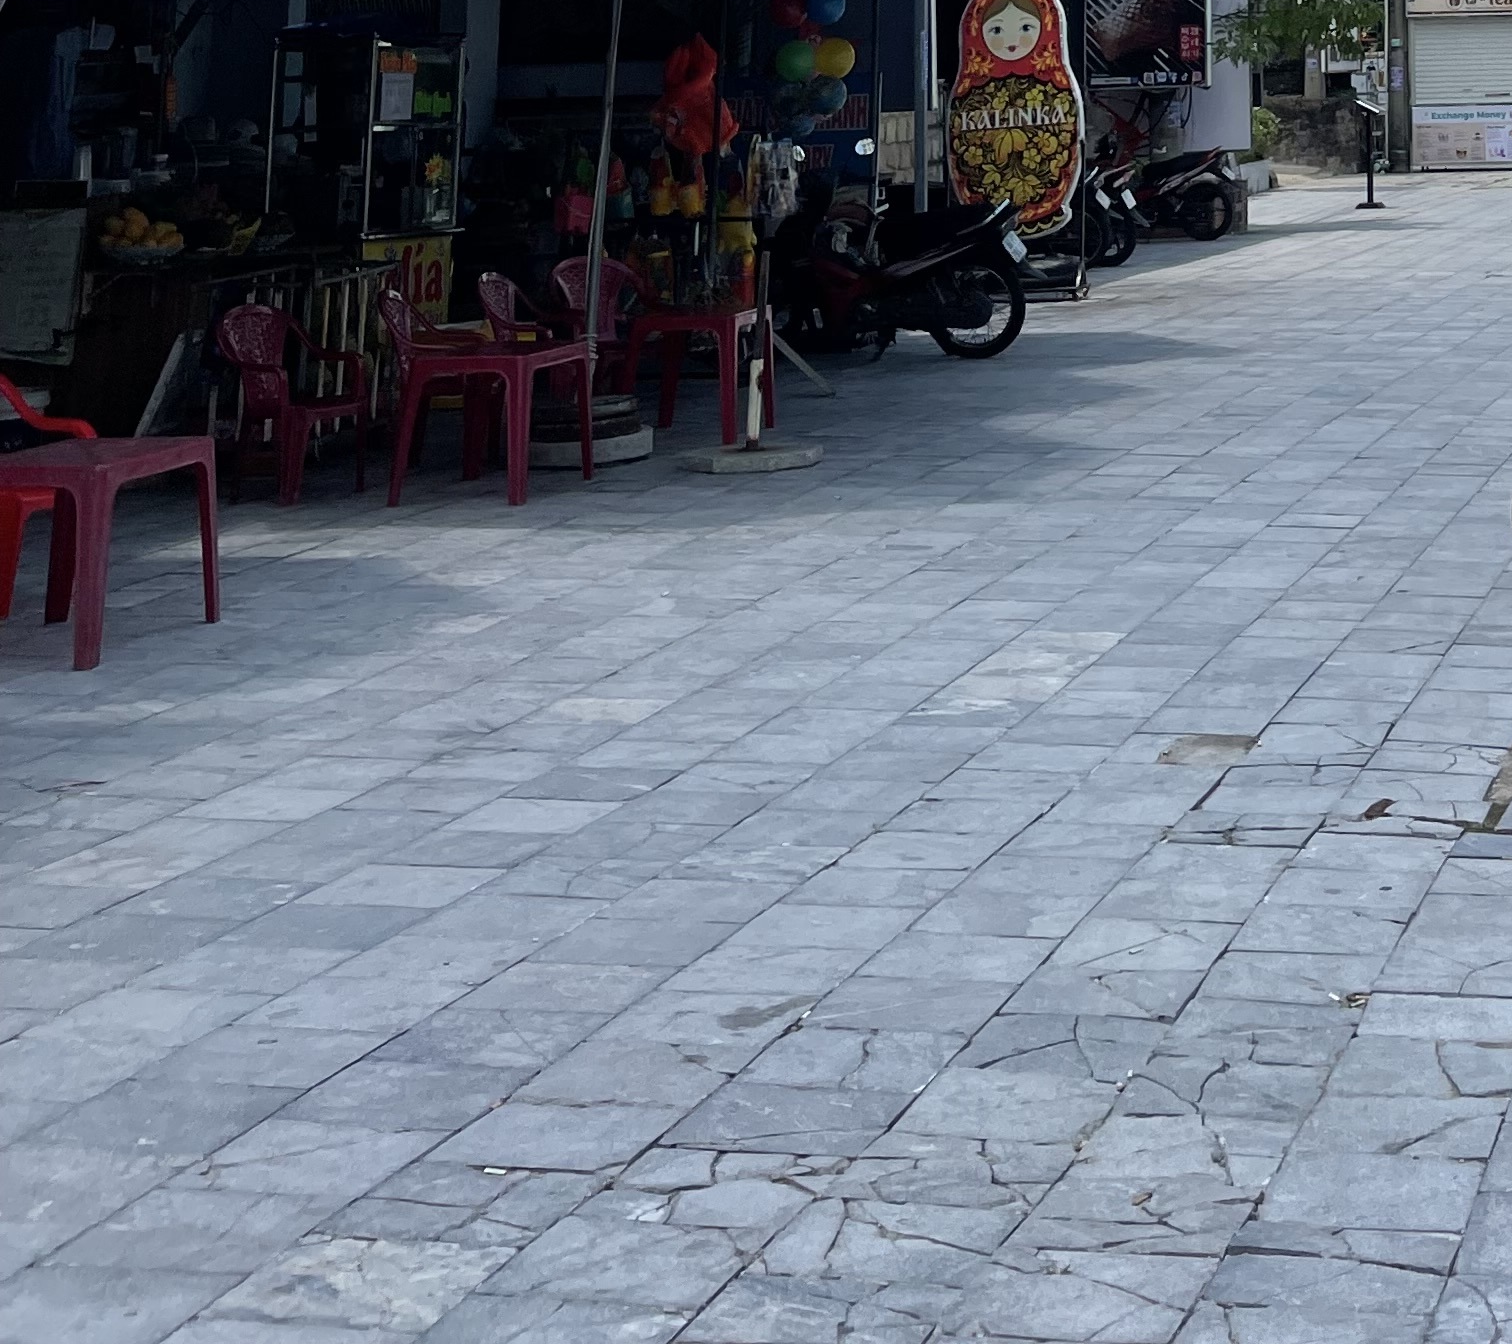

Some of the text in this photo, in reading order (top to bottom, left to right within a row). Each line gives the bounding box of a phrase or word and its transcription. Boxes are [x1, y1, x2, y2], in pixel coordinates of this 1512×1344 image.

[960, 104, 1068, 132] KALINKA
[1431, 111, 1507, 120] Exchange Money
